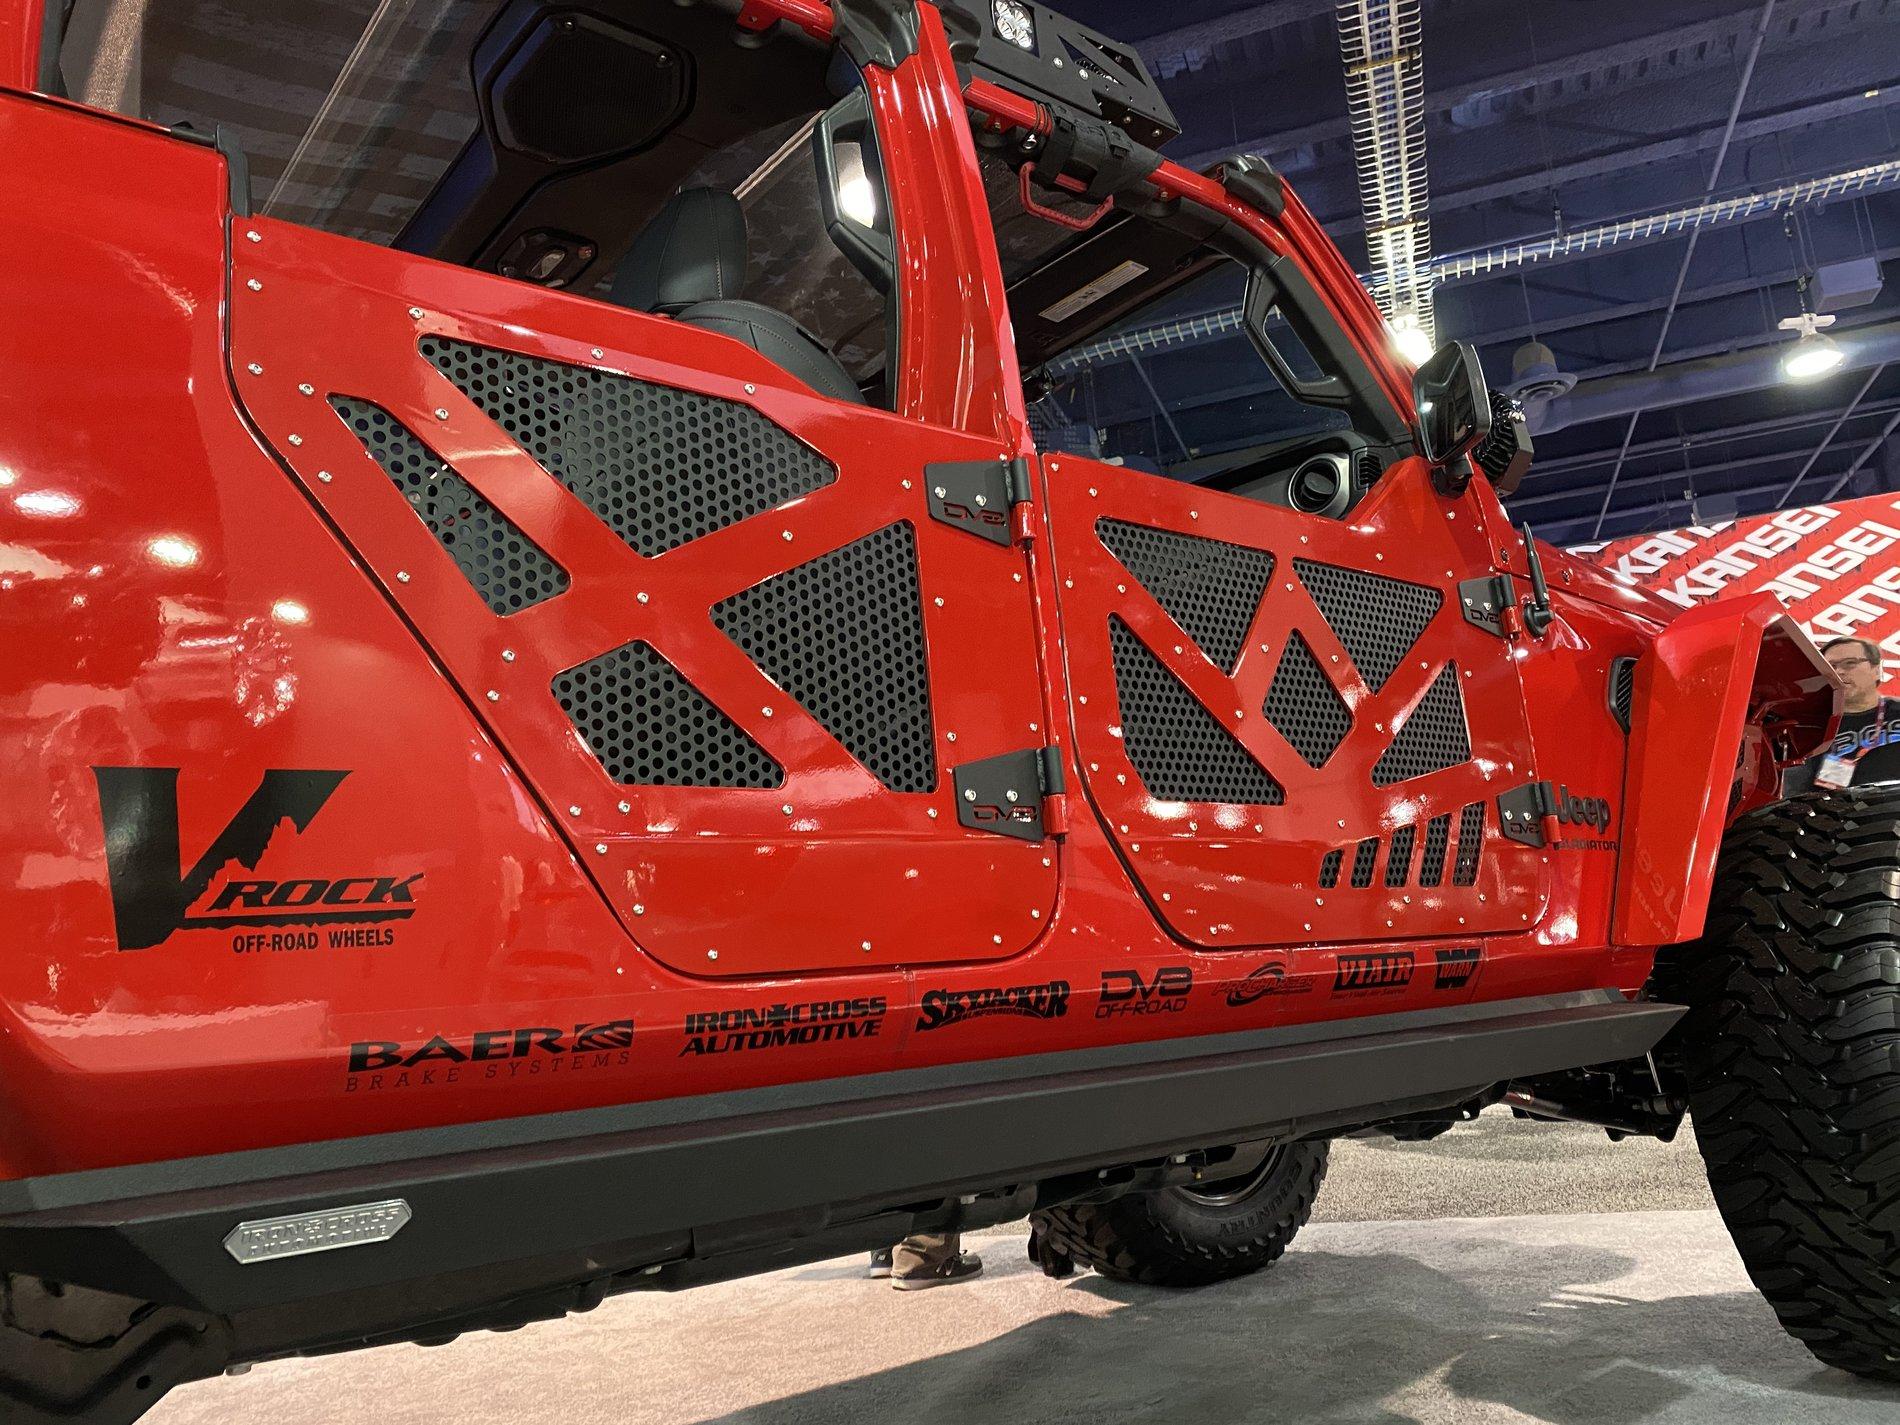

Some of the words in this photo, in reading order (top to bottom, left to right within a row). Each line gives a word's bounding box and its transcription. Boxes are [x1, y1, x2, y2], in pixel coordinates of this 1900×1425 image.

[1555, 784, 1611, 835] Jeep
[205, 872, 424, 912] ROCK
[232, 932, 318, 953] OFF-ROAD
[328, 928, 394, 949] WHEELS
[1101, 966, 1192, 1000] DV8
[1338, 956, 1413, 986] VIAIR
[684, 1008, 766, 1035] IRON
[790, 996, 887, 1024] CROSS
[348, 1027, 567, 1073] BAER
[678, 1018, 884, 1058] AUTOMOTIVE
[345, 1067, 460, 1093] BRAKE
[484, 1051, 631, 1079] SYSTEMS
